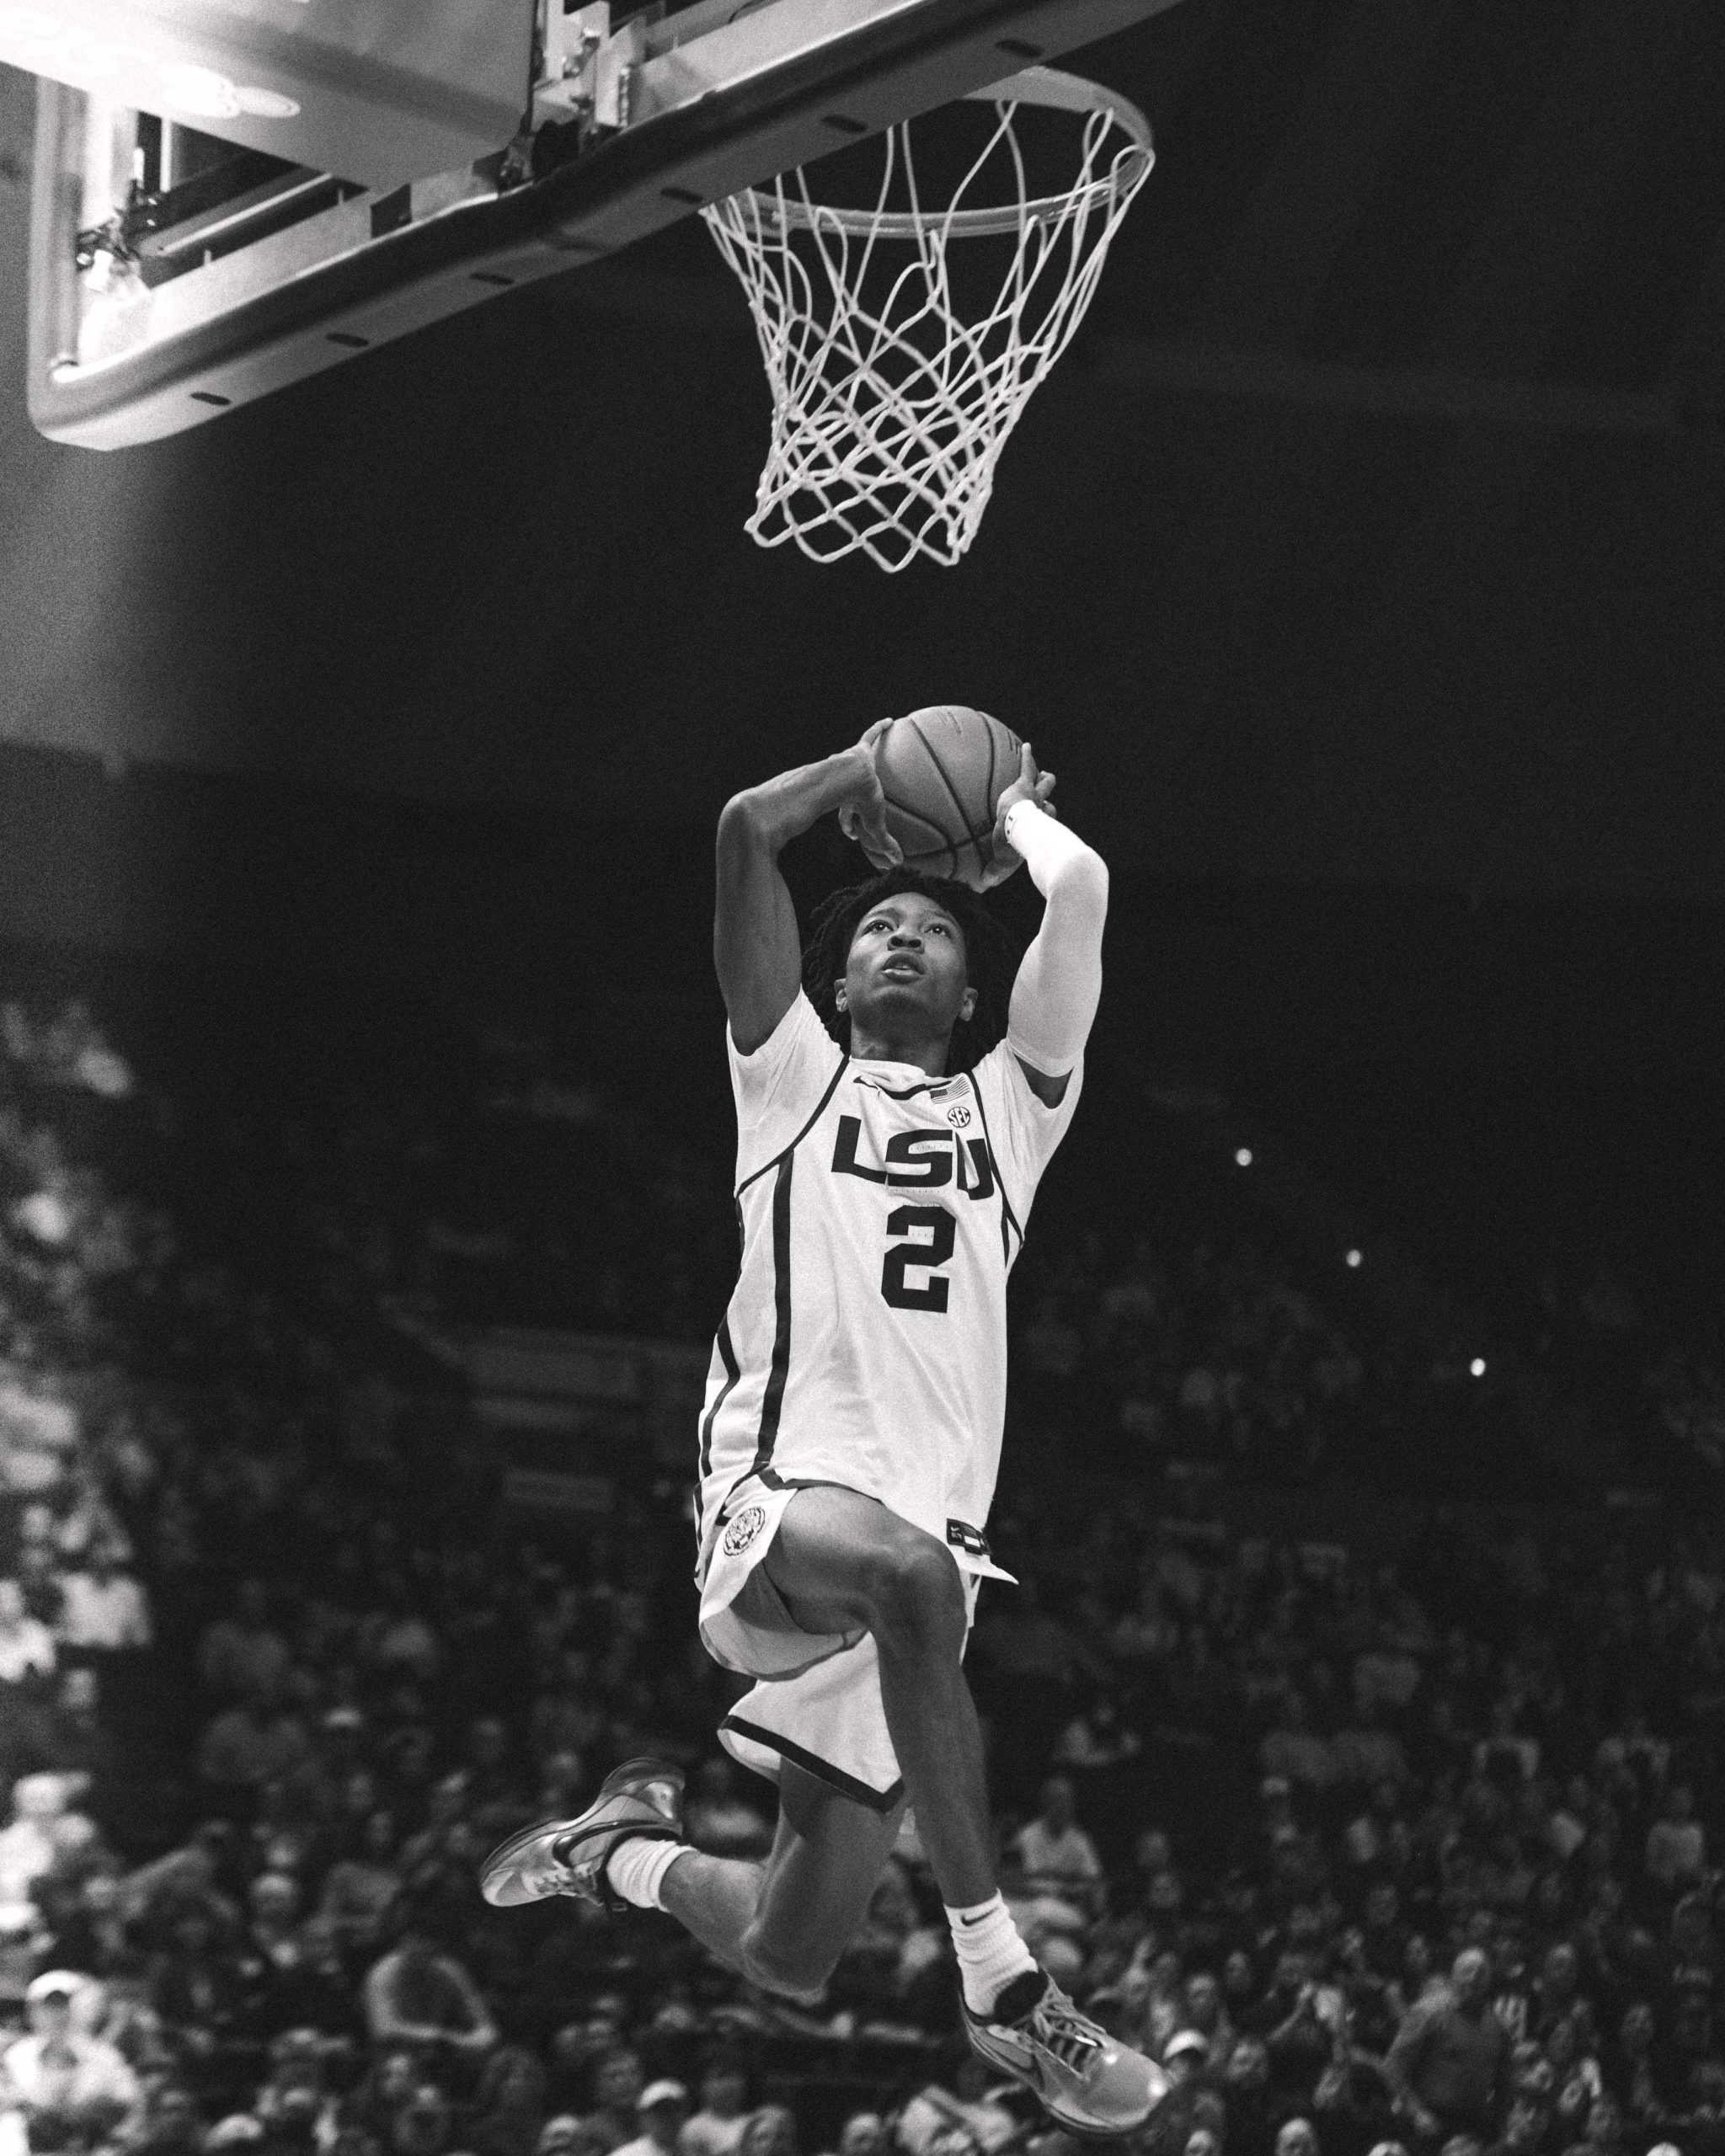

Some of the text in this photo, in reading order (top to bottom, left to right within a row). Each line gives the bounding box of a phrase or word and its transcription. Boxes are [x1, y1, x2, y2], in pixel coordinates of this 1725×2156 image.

[831, 1115, 995, 1200] LSU
[948, 1107, 970, 1128] SEC
[881, 1205, 956, 1313] 2
